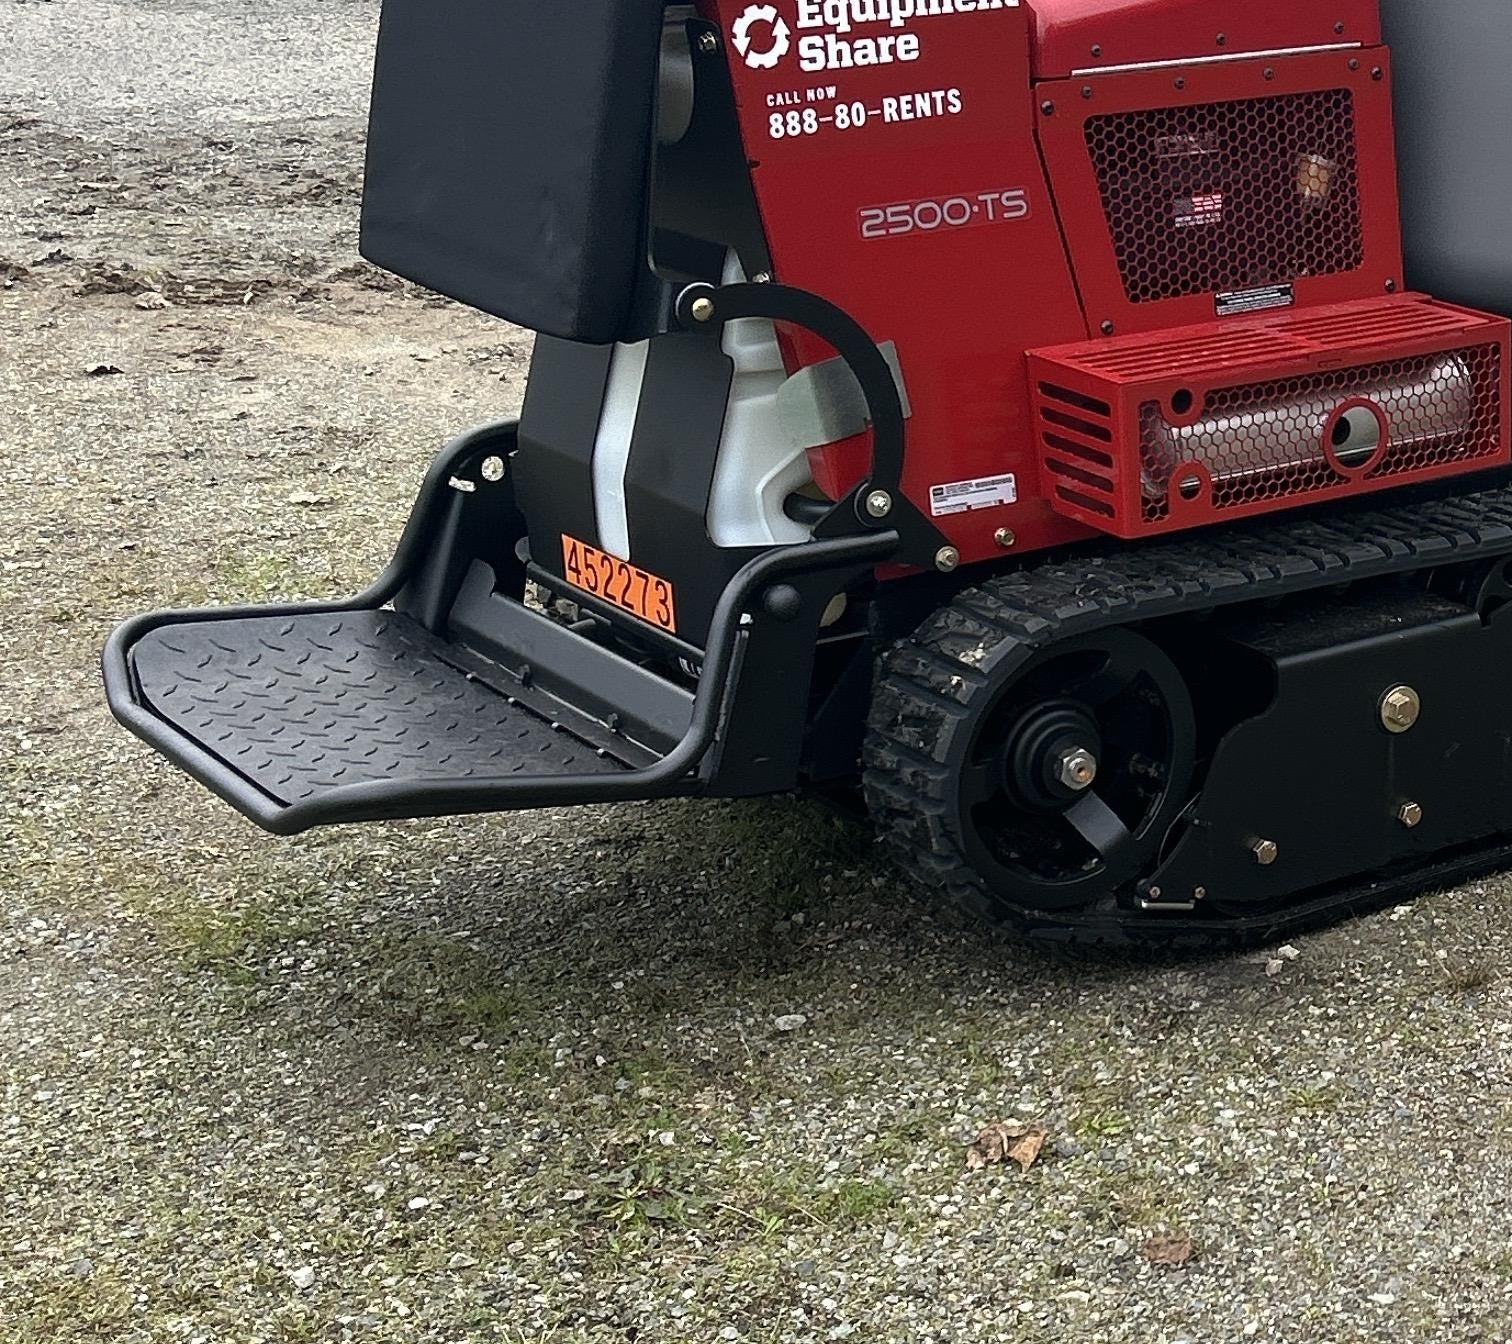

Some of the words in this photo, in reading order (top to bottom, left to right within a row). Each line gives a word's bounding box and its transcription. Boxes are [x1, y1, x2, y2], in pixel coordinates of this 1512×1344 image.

[799, 33, 919, 72] Share
[766, 90, 801, 106] CALL
[806, 85, 837, 100] NOW
[769, 88, 962, 139] 888-80-RENTS
[567, 541, 671, 626] 452273
